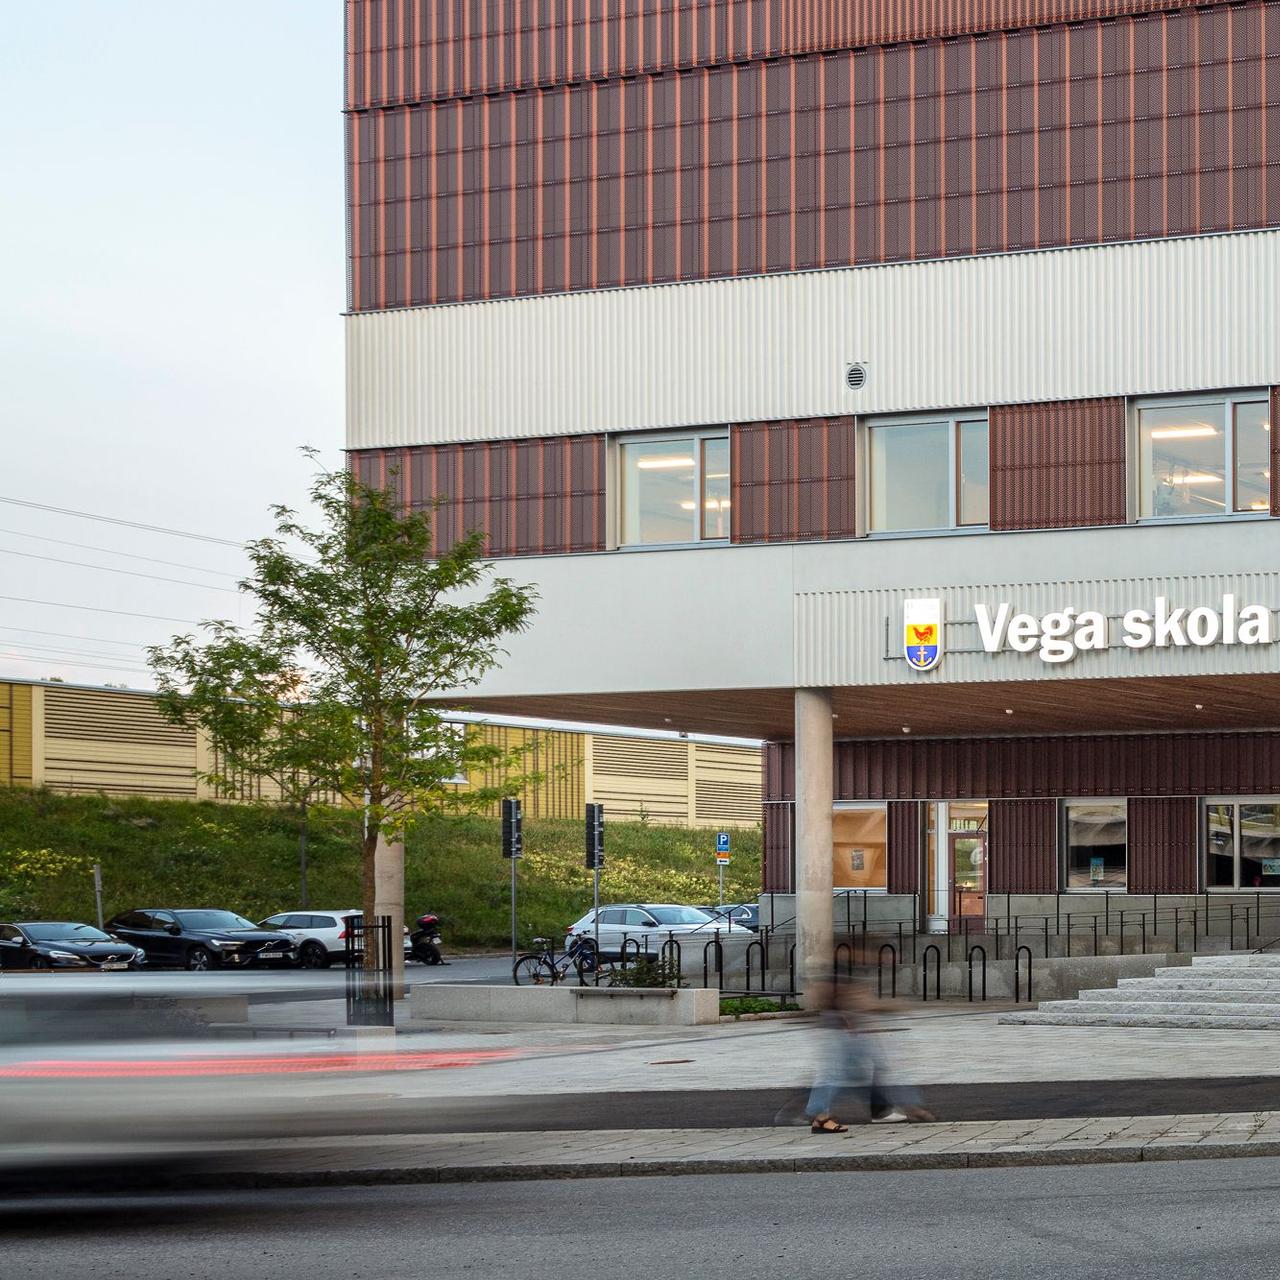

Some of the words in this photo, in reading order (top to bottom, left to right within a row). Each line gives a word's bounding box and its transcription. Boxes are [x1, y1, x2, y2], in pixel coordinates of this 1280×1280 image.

[974, 603, 1109, 663] Vega
[1122, 594, 1272, 648] skola
[720, 835, 728, 845] P
